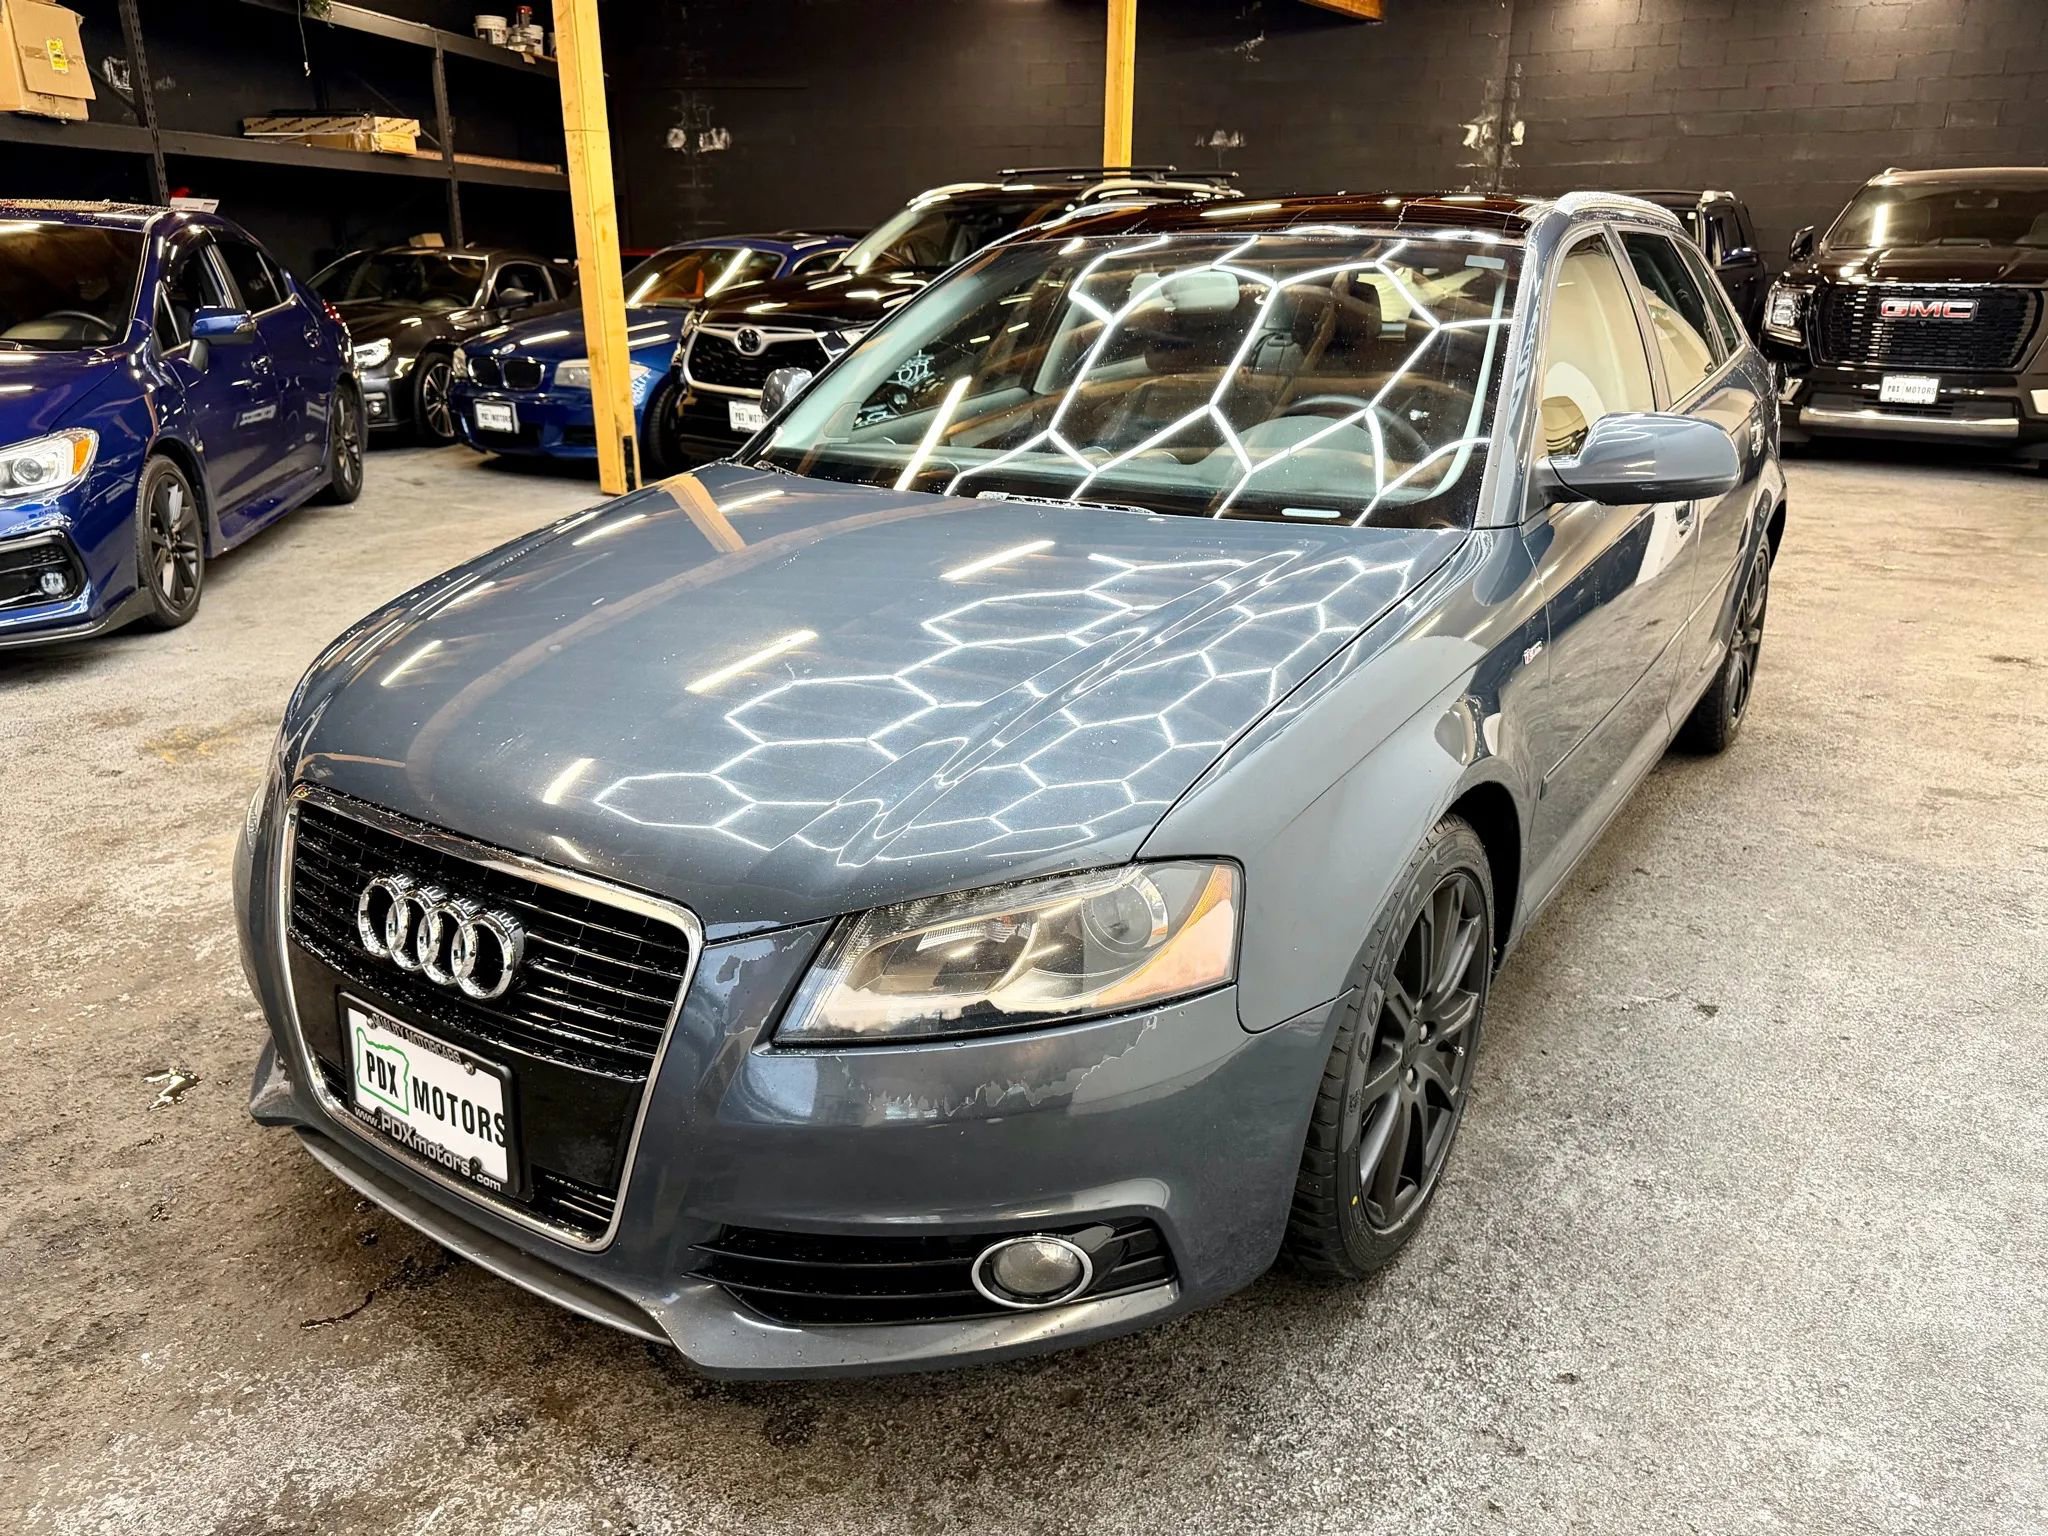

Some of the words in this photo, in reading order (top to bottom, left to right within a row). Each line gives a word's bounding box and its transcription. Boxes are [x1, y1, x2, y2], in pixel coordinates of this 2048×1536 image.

[1881, 300, 1974, 318] GMC
[366, 1050, 399, 1099] PDX
[412, 1075, 506, 1148] MOTORS
[354, 1105, 502, 1192] www.PDXmotors.com
